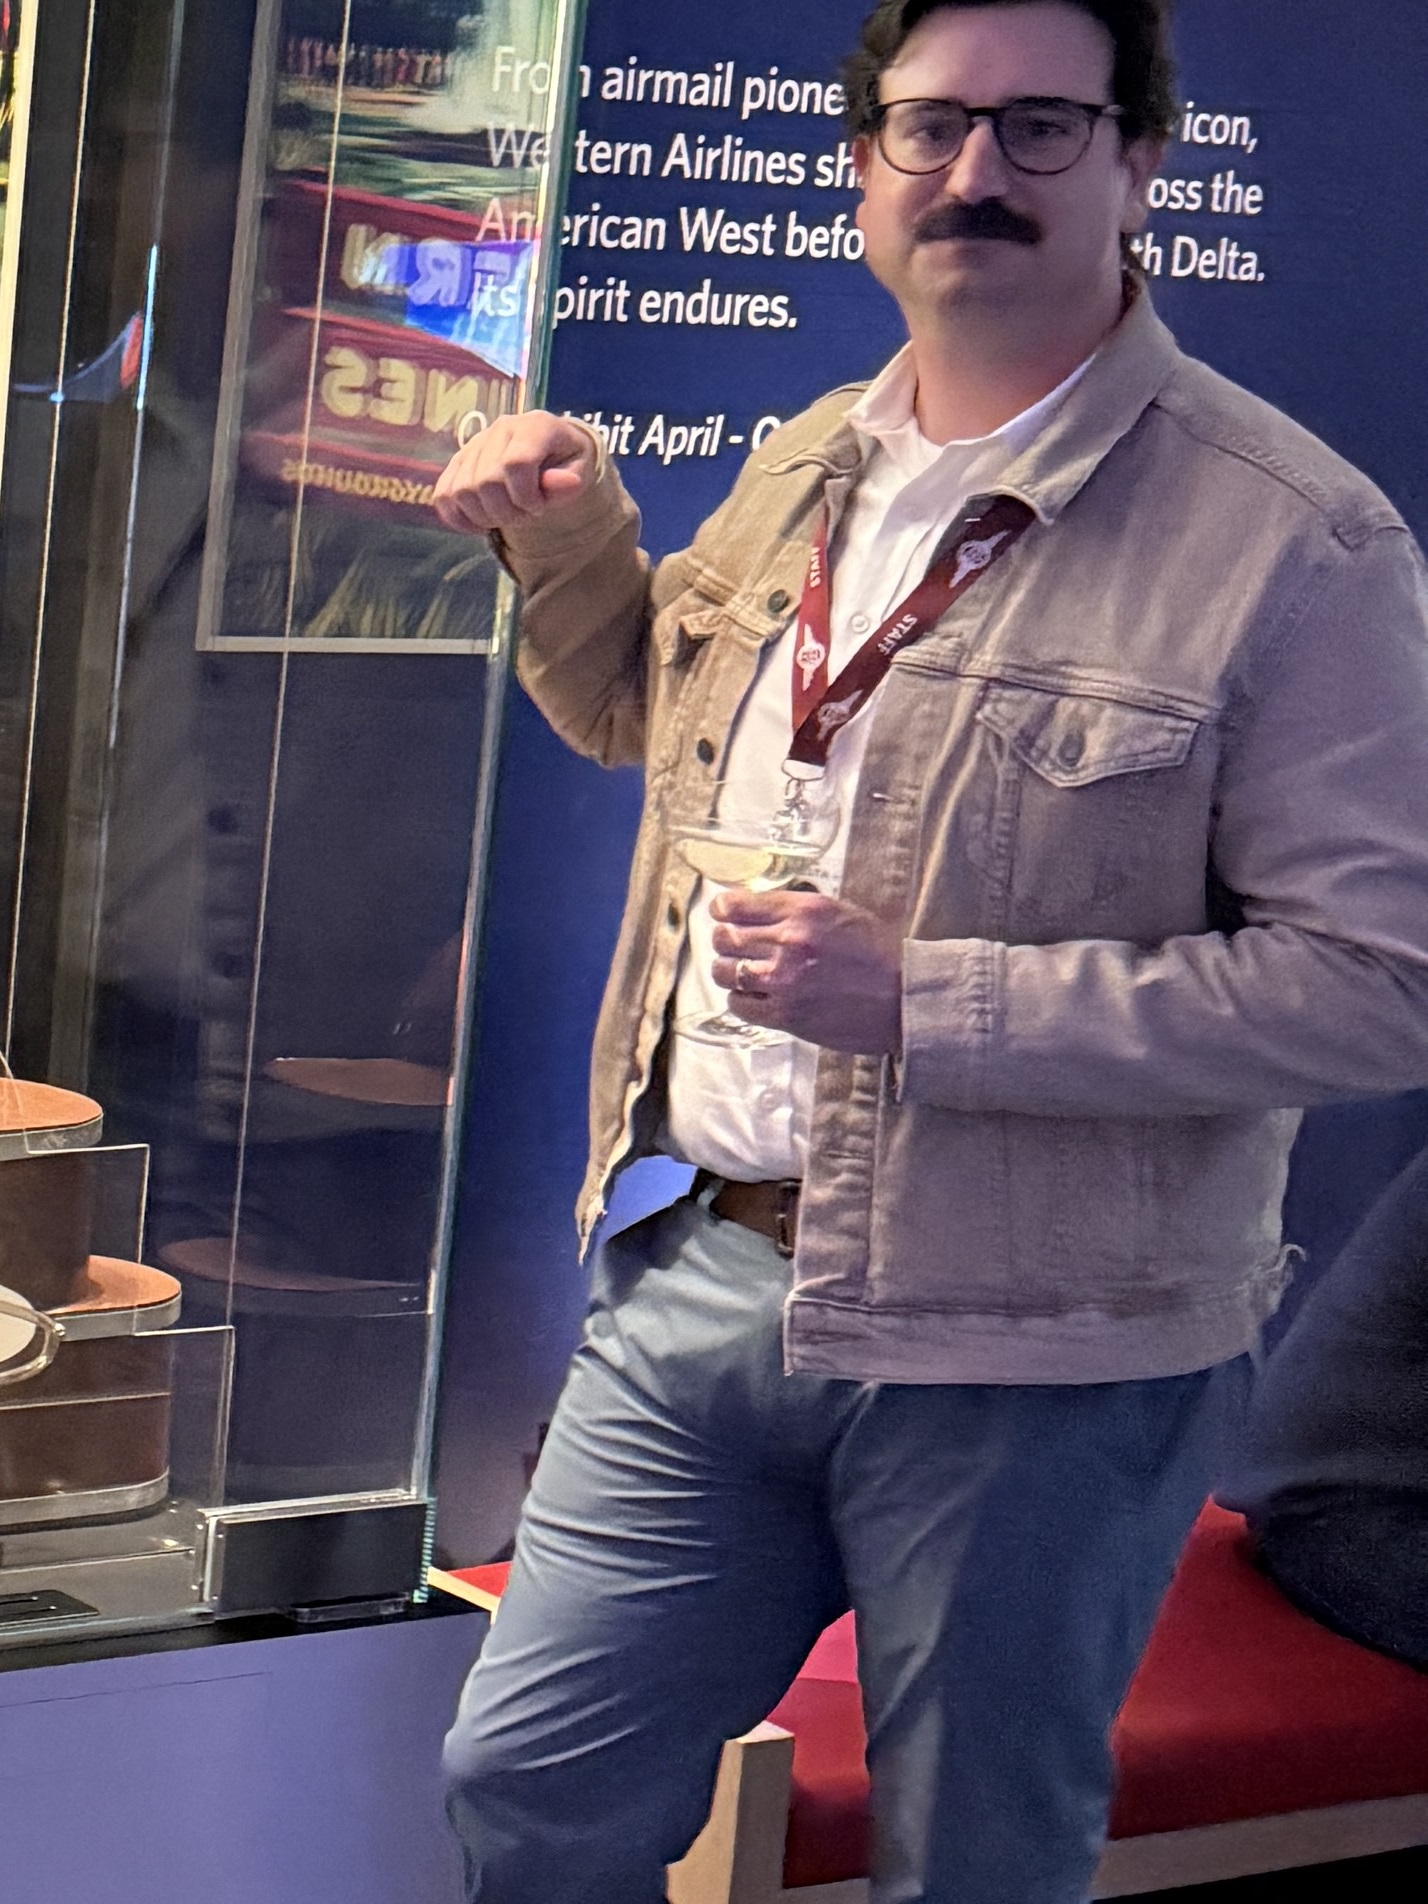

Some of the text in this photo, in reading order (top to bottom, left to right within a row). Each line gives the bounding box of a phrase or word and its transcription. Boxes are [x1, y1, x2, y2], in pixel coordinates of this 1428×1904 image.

[600, 55, 735, 108] airmail
[1180, 100, 1259, 154] icon,
[486, 119, 653, 178] Wetern
[660, 132, 807, 187] Airlines
[1210, 169, 1264, 216] the
[678, 205, 777, 258] West
[1170, 234, 1266, 283] Delta.
[540, 274, 630, 330] pirit
[638, 278, 798, 330] endures.
[637, 413, 726, 466] April
